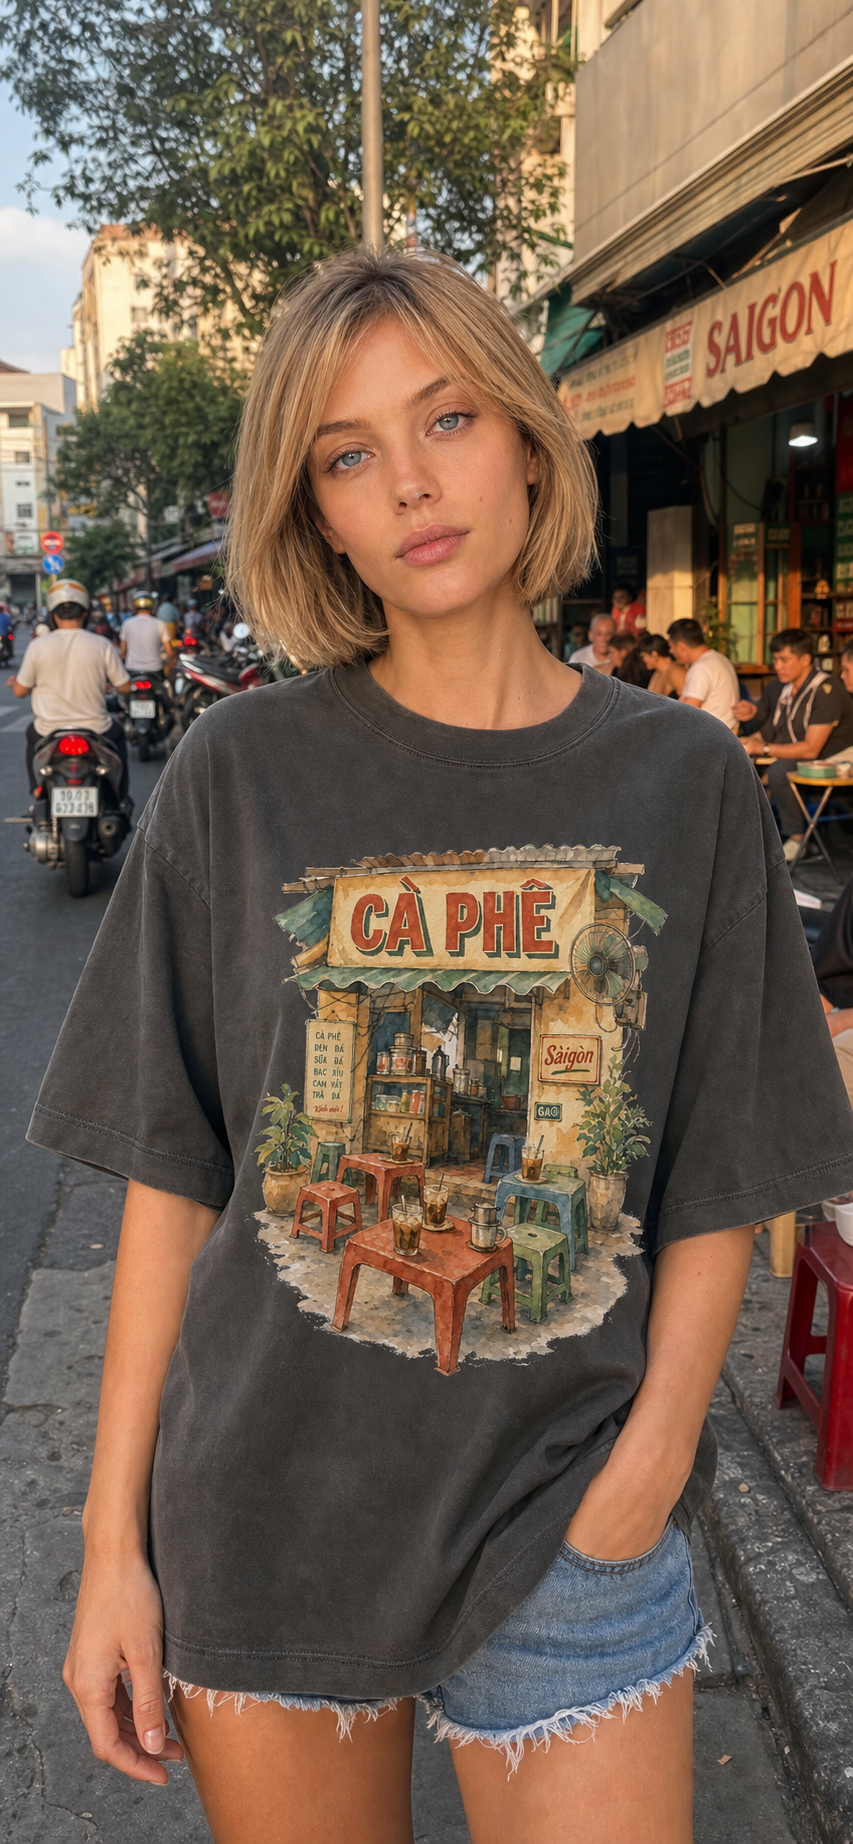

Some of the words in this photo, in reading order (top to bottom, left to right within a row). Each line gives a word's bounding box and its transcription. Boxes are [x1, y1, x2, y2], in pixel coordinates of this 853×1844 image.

[706, 259, 837, 378] SAIGON
[350, 875, 434, 957] CÀ
[445, 878, 559, 959] PHÊ
[544, 1044, 594, 1070] Sàigòn
